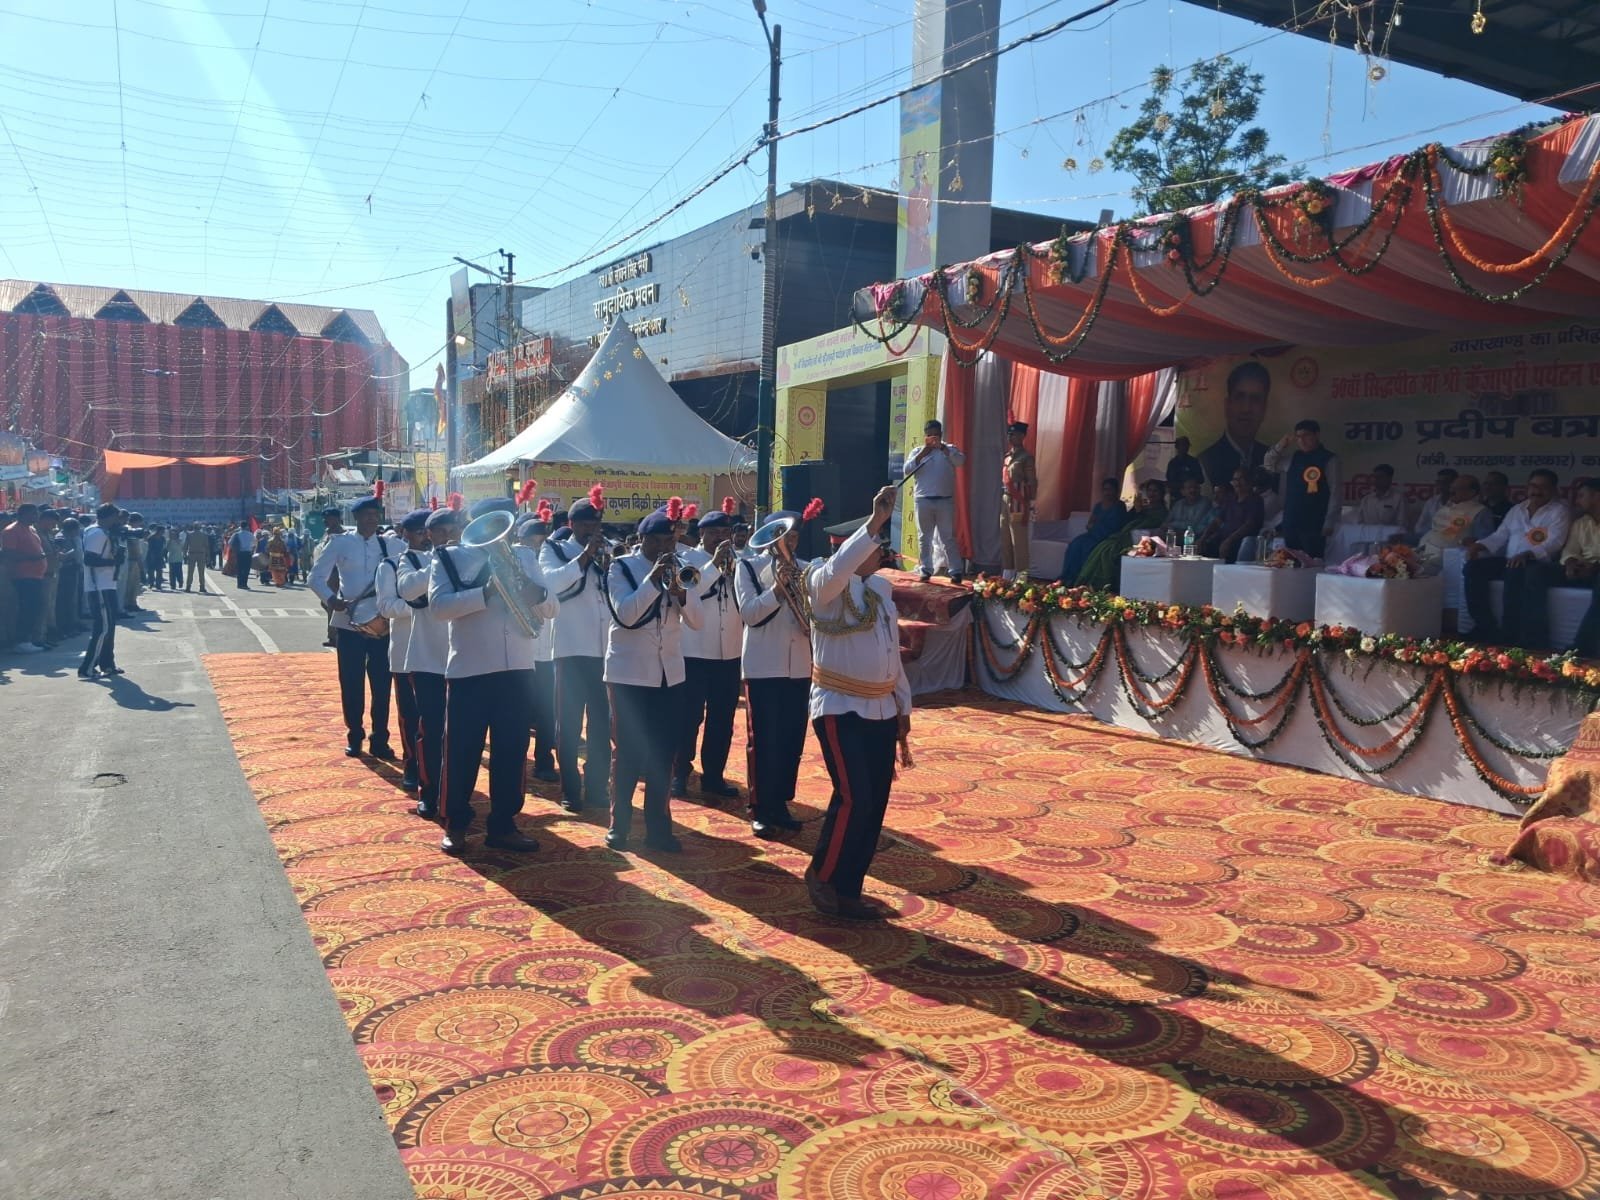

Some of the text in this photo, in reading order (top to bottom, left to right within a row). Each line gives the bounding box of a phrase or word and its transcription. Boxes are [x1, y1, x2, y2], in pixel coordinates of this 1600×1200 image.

[592, 283, 655, 325] सामुदायिक भवन
[1449, 334, 1524, 353] उत्तराखण्ड
[1529, 332, 1552, 346] का
[1532, 357, 1585, 387] पर्यटन
[1415, 408, 1520, 445] प्रदीप
[608, 497, 631, 515] कूपन
